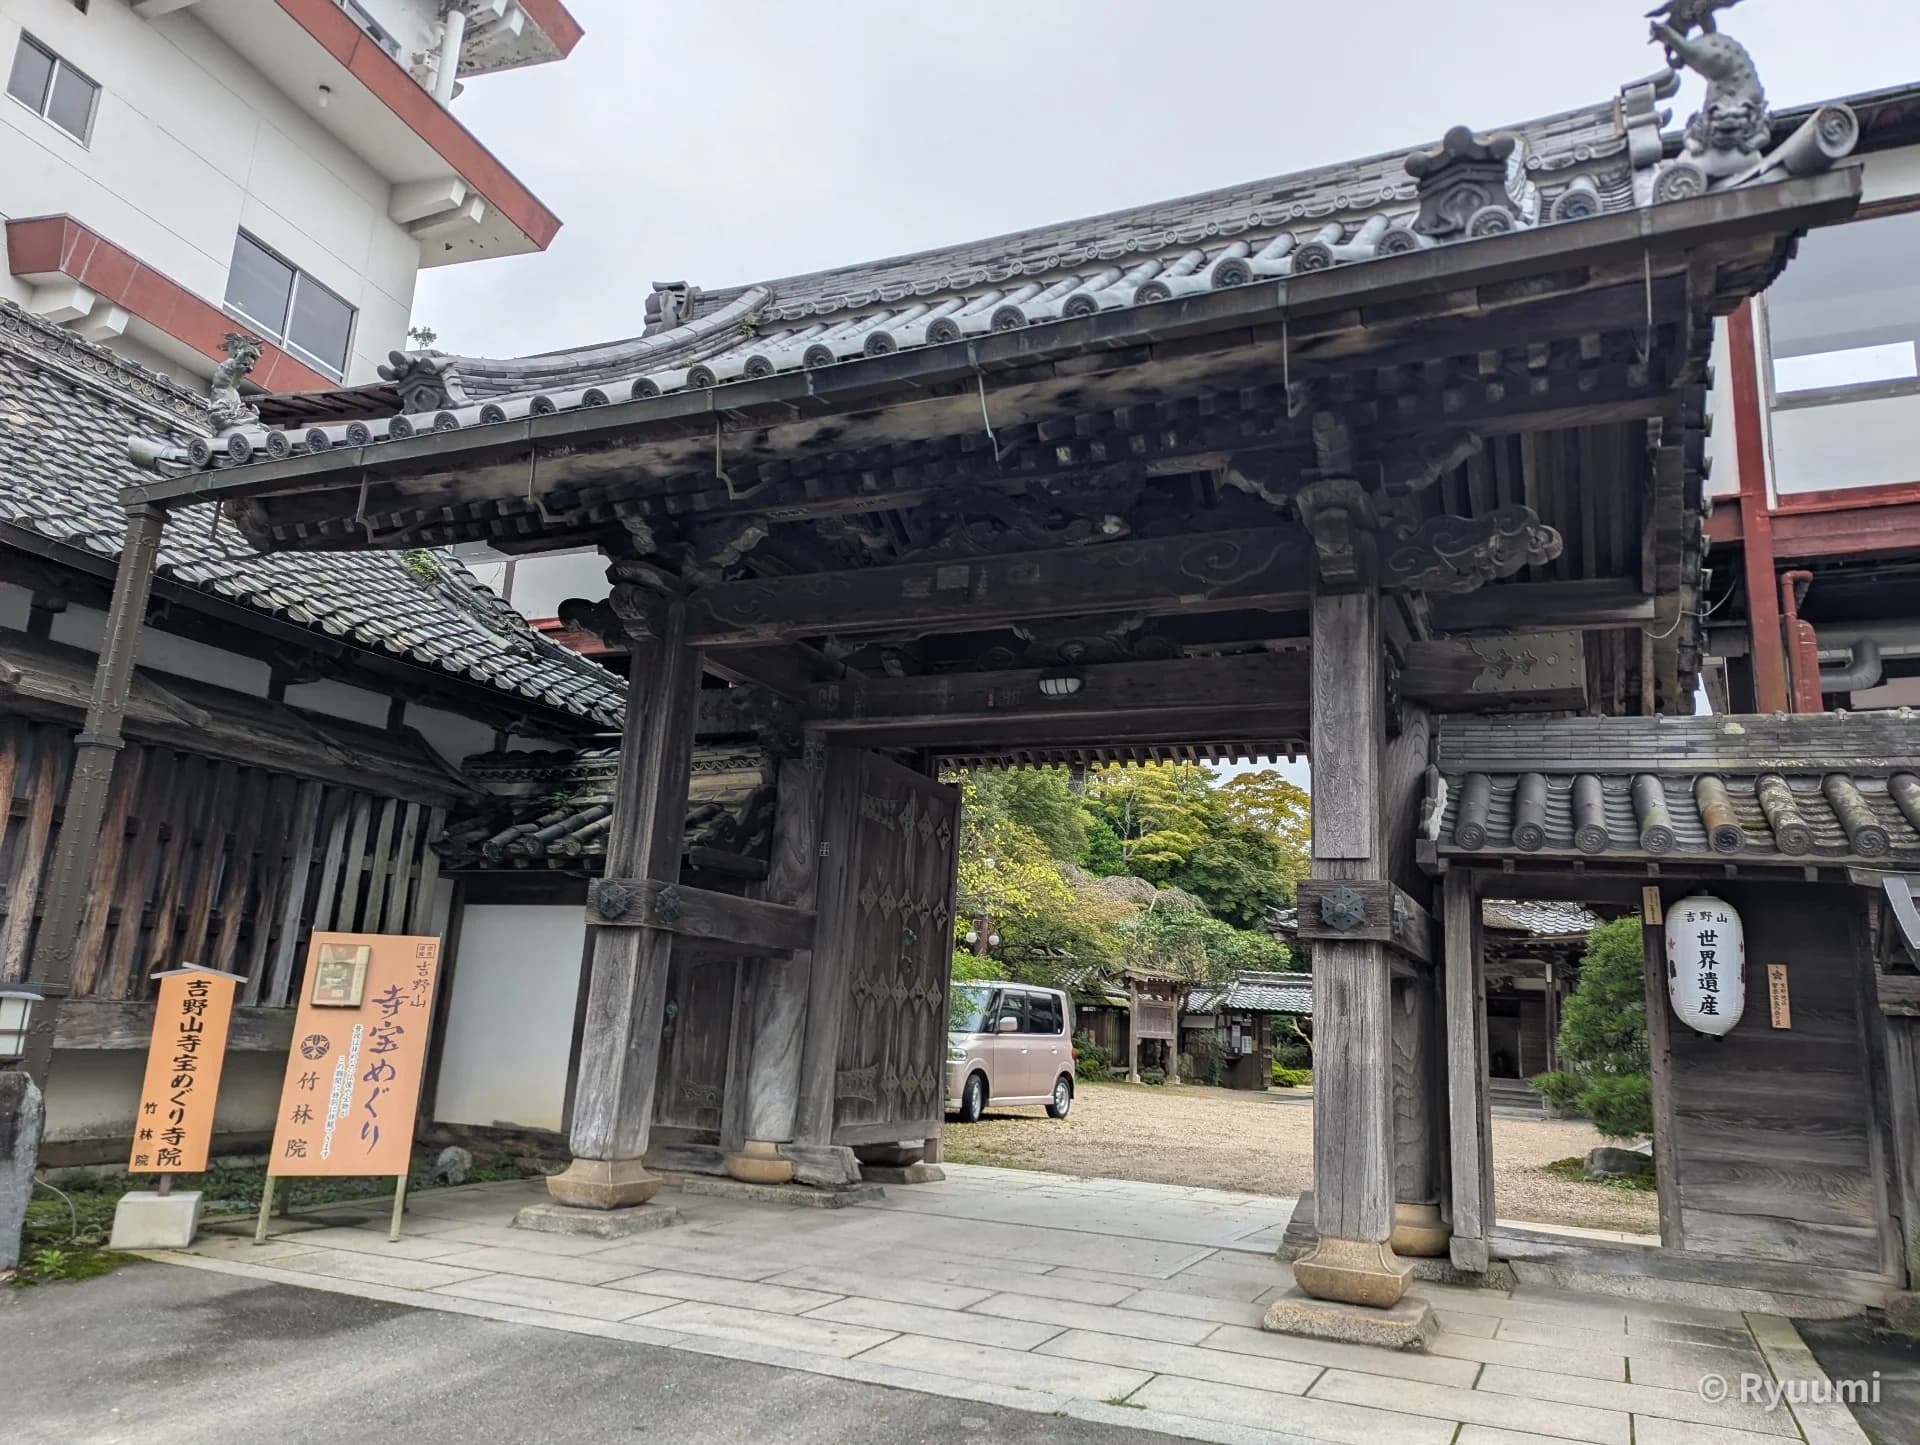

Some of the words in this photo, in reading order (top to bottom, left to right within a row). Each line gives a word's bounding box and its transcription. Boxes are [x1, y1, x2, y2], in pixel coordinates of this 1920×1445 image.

[1685, 911, 1728, 924] 吉野山
[410, 960, 431, 1008] 吉野山
[1697, 929, 1721, 1016] 世界遺産
[156, 979, 213, 1167] 吉野山寺宝めぐり寺院
[360, 984, 410, 1156] 寺宝めぐり
[135, 1102, 157, 1167] 竹林院
[284, 1071, 320, 1159] 竹林院
